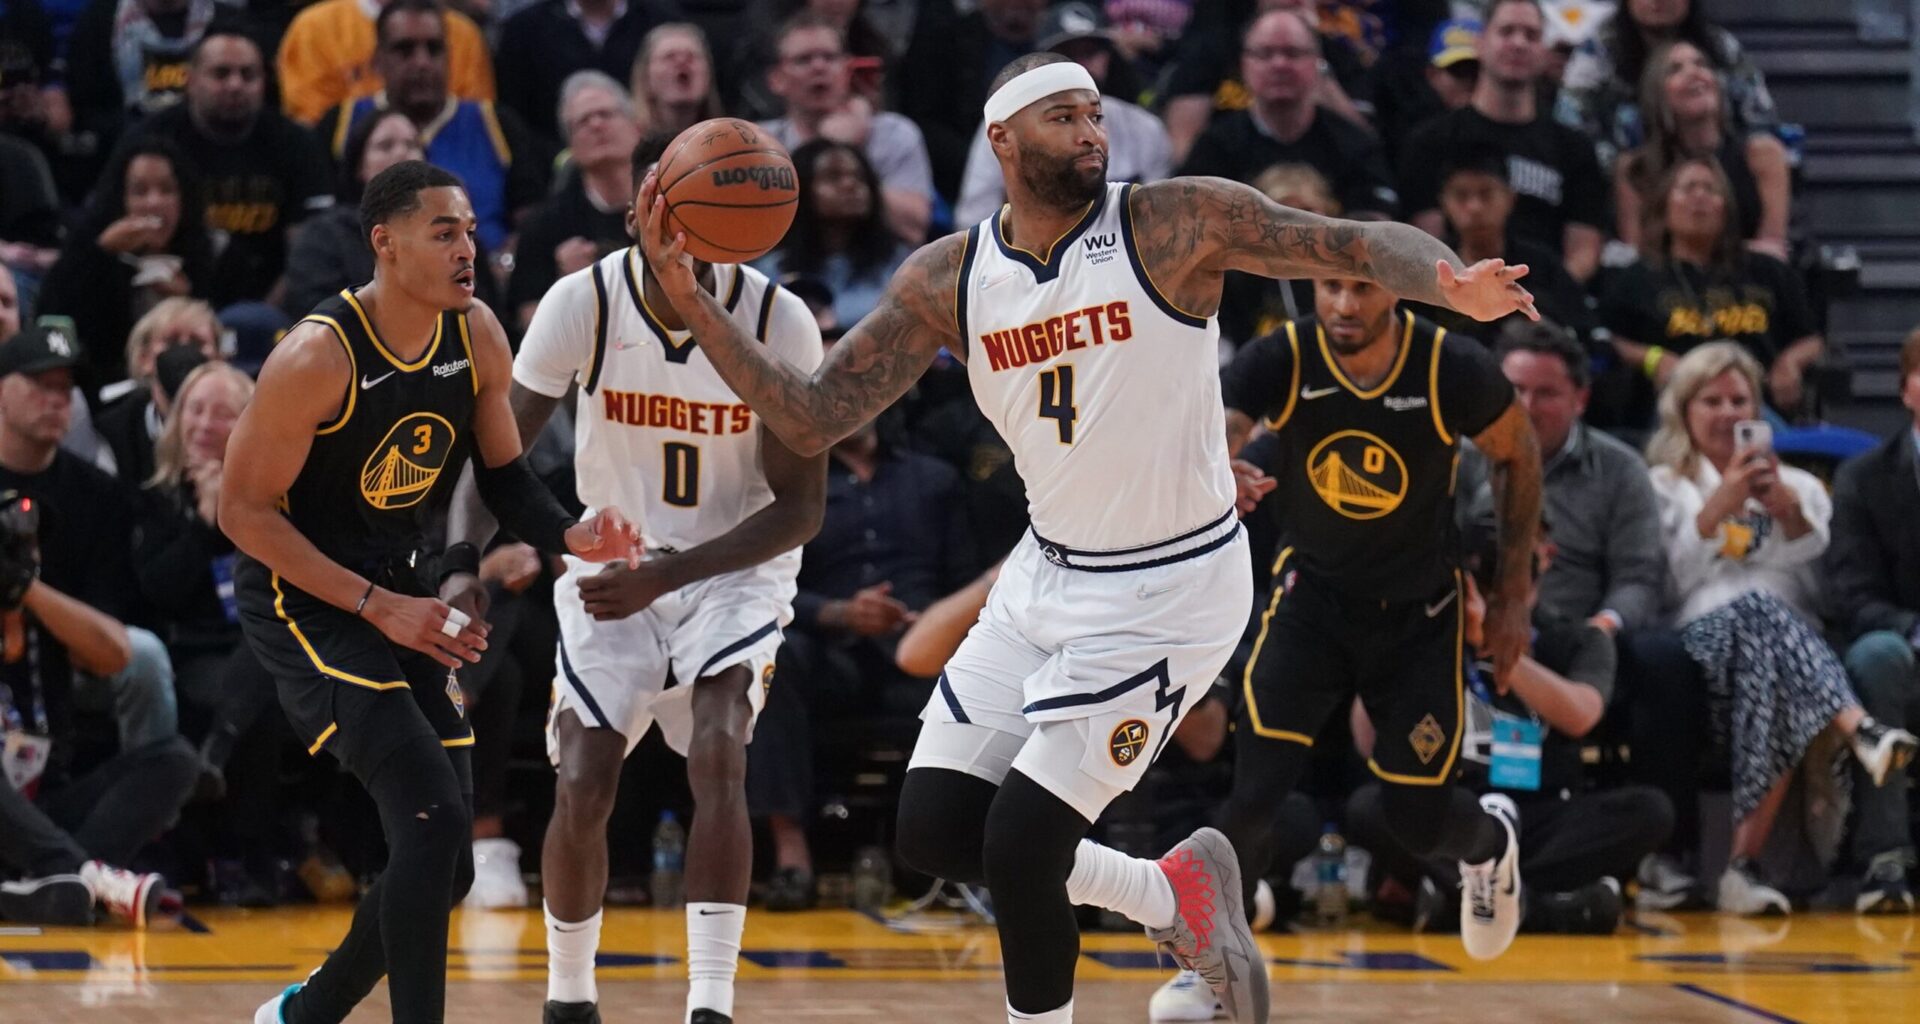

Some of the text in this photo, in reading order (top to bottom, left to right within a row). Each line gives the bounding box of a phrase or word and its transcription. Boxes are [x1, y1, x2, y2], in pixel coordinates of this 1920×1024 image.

[712, 166, 796, 191] Wilson
[1084, 232, 1116, 251] WU
[1085, 248, 1118, 259] Western
[1091, 255, 1114, 265] Union
[980, 300, 1133, 373] NUGGETS
[432, 358, 470, 377] Rakuten
[602, 388, 751, 436] NUGGETS
[1038, 363, 1079, 446] 4
[412, 424, 432, 455] 3
[661, 440, 700, 508] 0
[1363, 445, 1385, 475] 0
